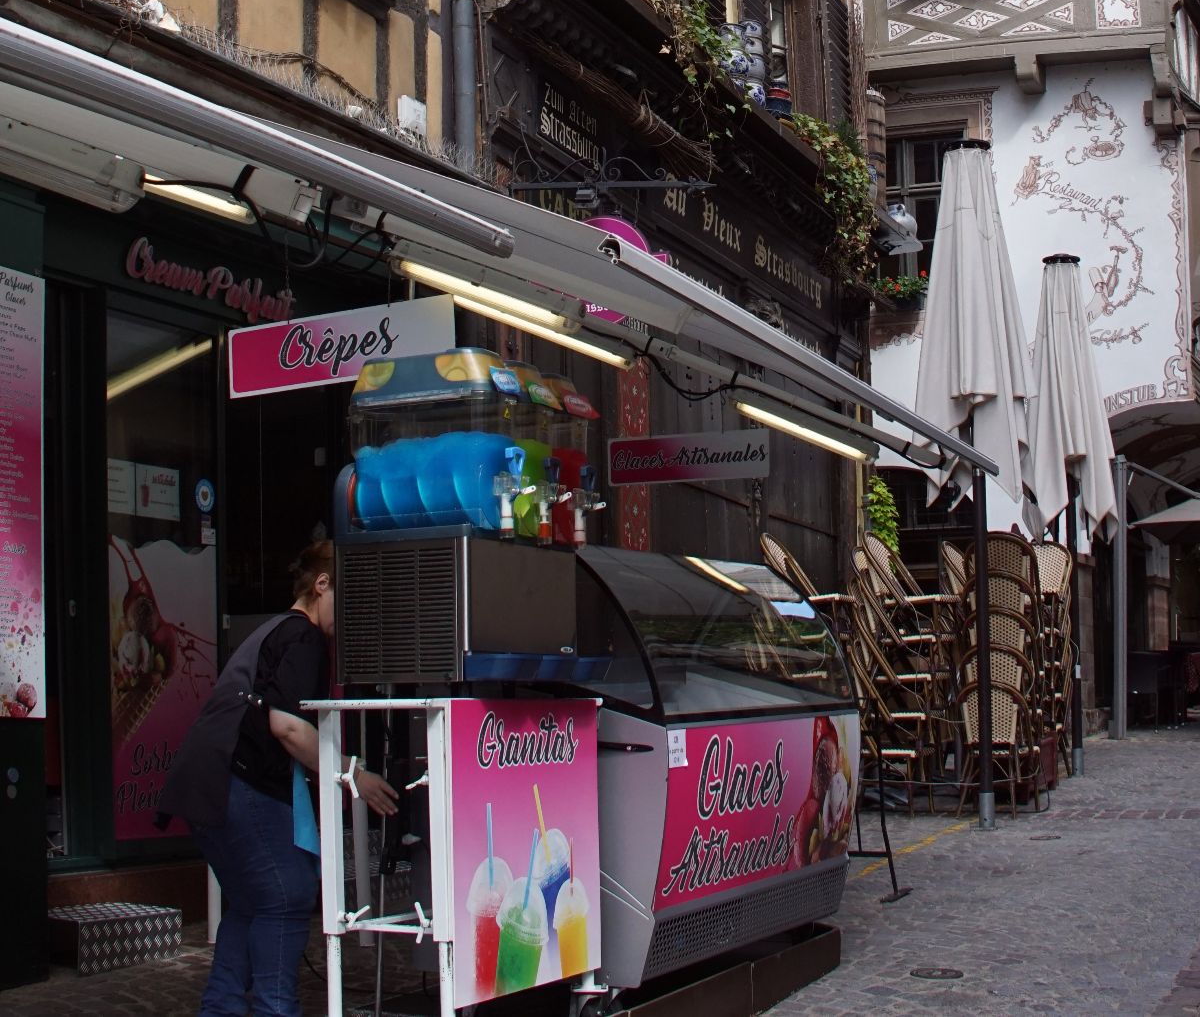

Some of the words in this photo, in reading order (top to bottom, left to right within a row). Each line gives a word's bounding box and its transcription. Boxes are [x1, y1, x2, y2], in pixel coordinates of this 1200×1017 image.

[544, 82, 564, 114] Zum
[540, 106, 600, 171] Strassburg
[1038, 171, 1103, 210] Restaurant
[126, 236, 204, 296] Cream
[204, 266, 296, 323] Parfait
[702, 197, 741, 253] Vieux
[754, 234, 823, 310] Strasbourg
[279, 316, 399, 377] Crêpes
[612, 449, 665, 471] Glaces
[666, 442, 768, 467] Artisanales
[477, 710, 579, 769] Granitas
[696, 734, 789, 820] Glaces
[662, 813, 796, 897] Artisanales
